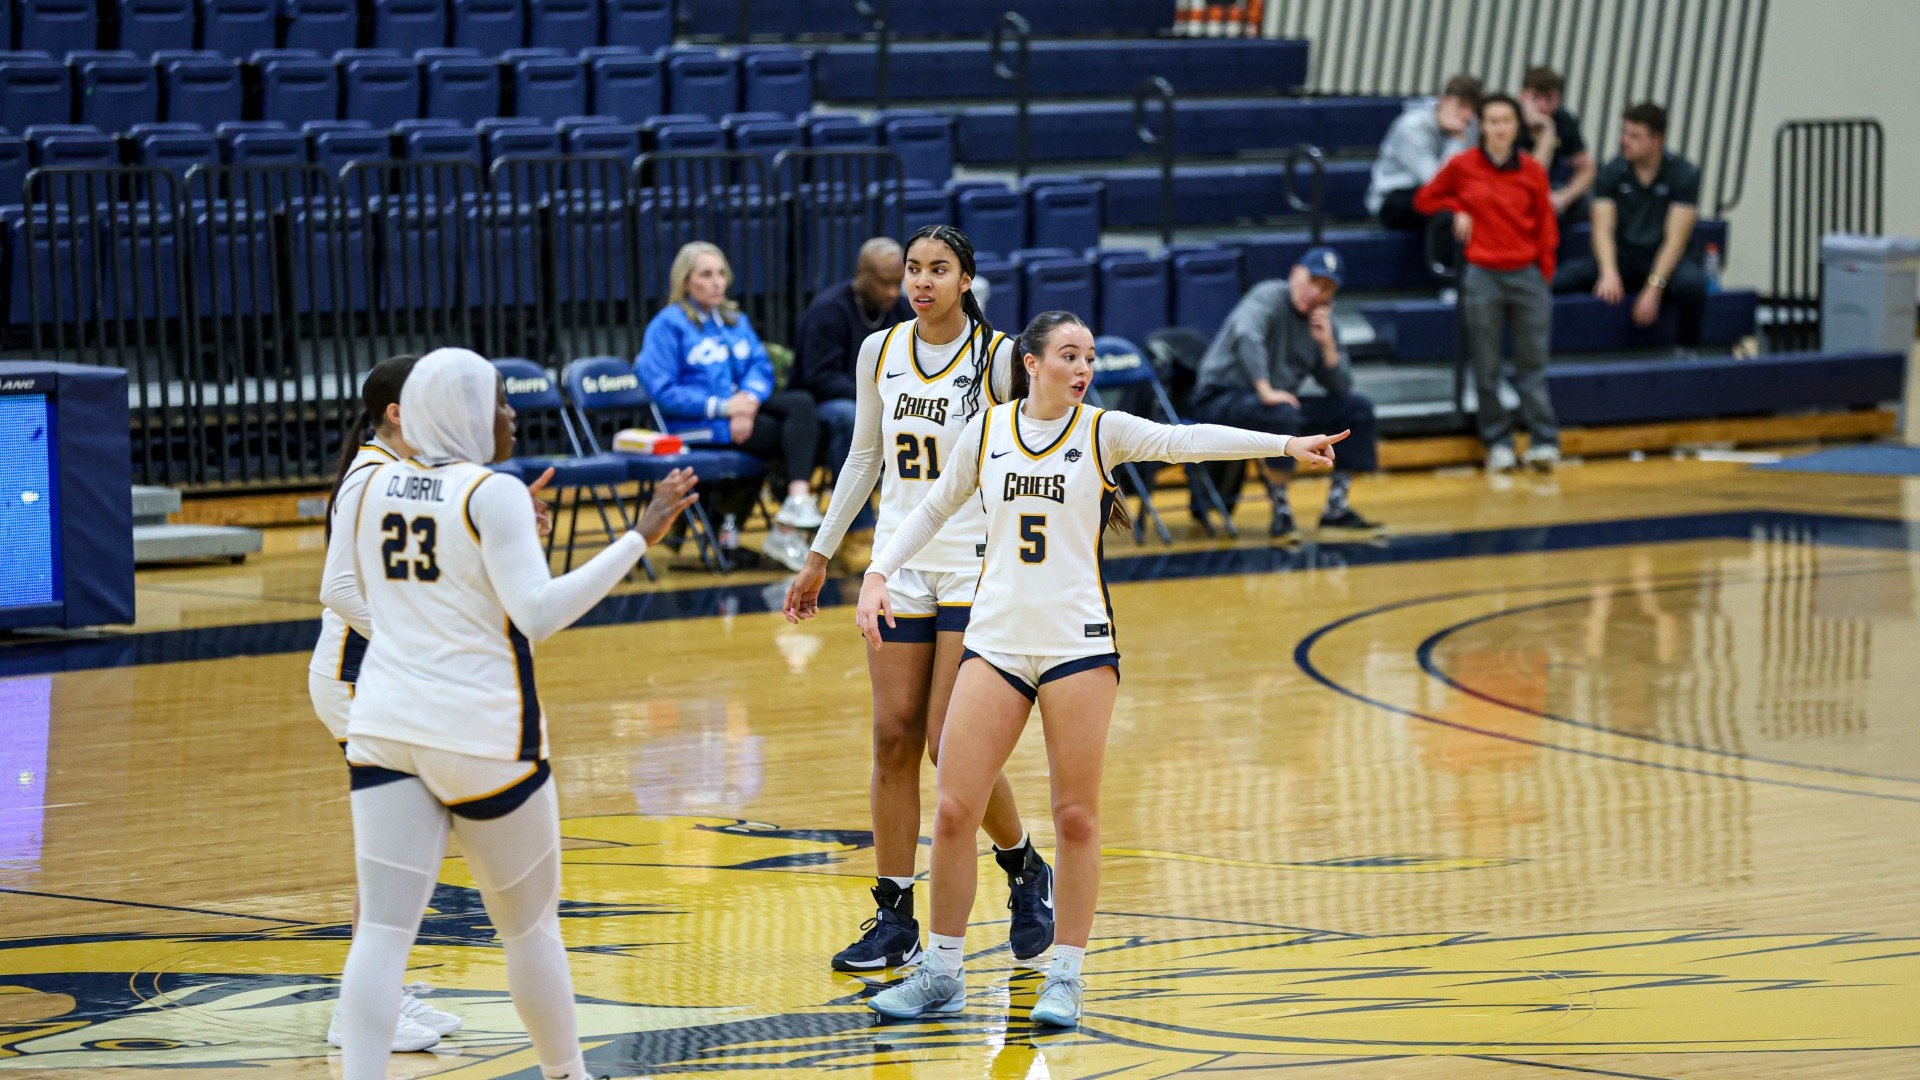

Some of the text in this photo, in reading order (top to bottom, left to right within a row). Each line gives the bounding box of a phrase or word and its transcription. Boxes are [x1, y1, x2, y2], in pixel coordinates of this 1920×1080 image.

[893, 392, 949, 427] GRIFFS
[895, 432, 941, 481] 21
[386, 475, 444, 502] DJIBRIL
[1003, 472, 1065, 505] GRIFFS
[381, 512, 442, 582] 23
[1018, 513, 1047, 565] 5
